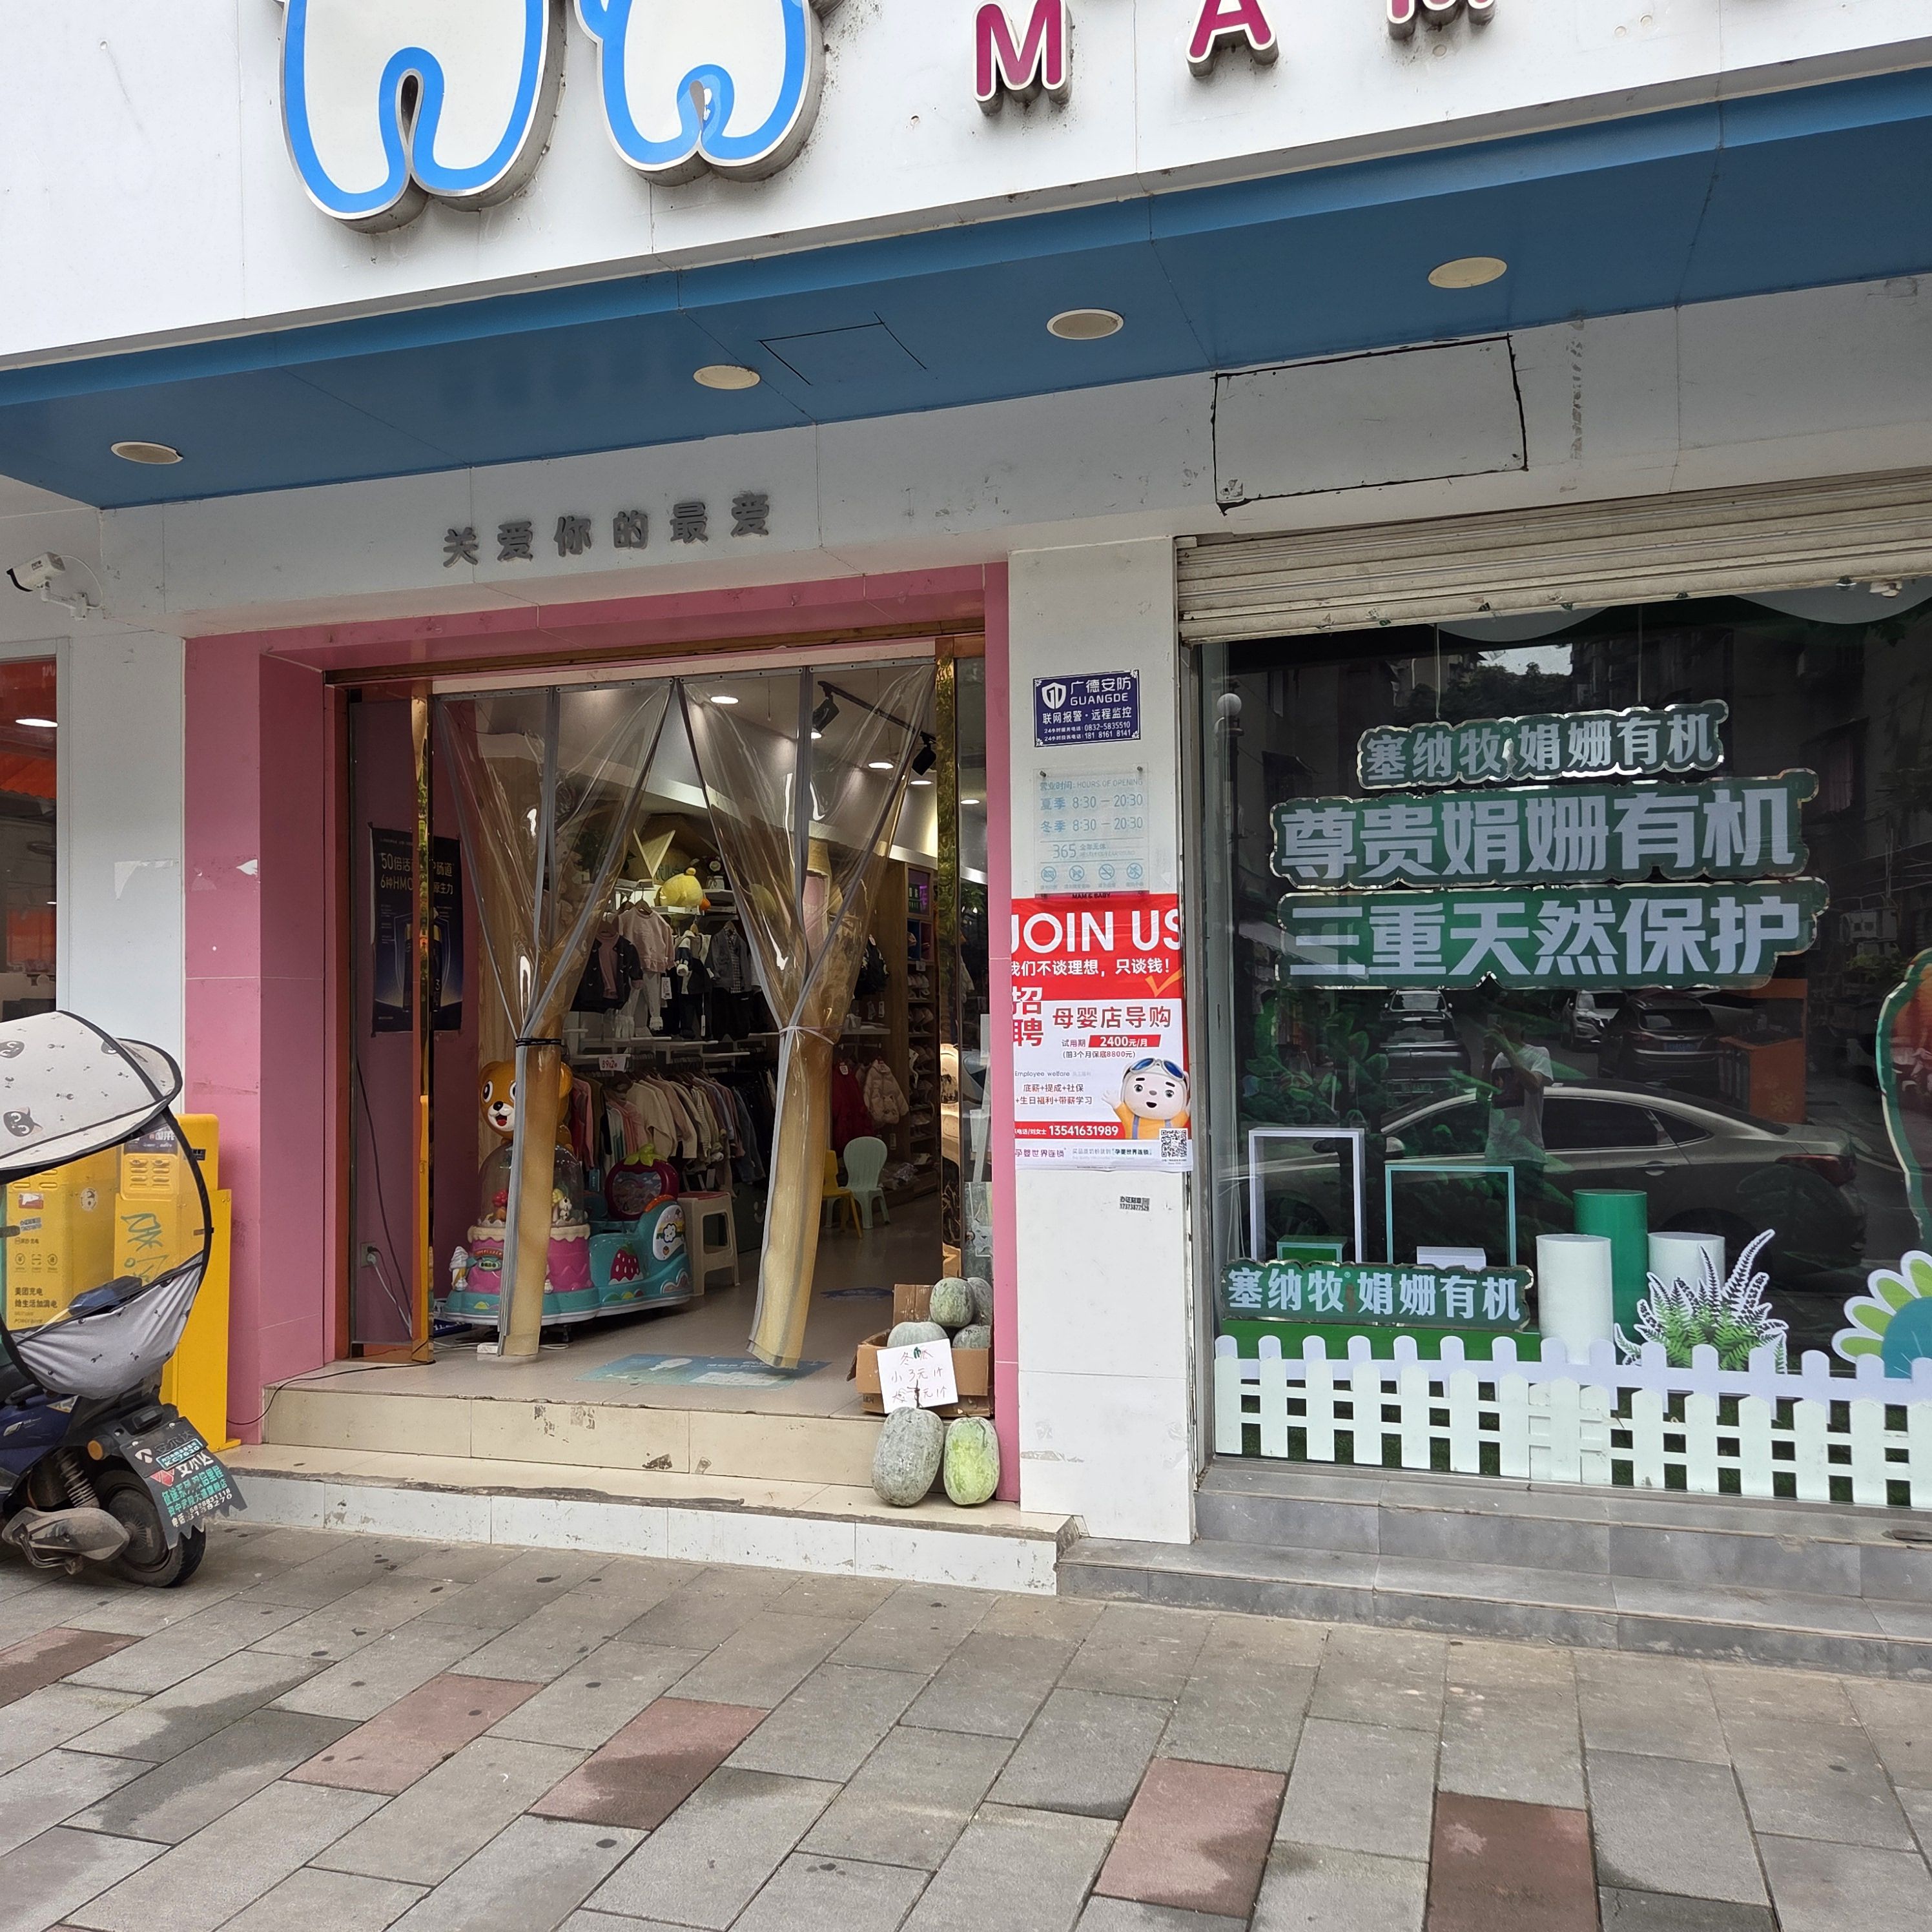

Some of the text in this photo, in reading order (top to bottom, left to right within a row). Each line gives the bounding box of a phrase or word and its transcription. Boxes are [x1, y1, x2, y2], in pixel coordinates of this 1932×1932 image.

[443, 493, 768, 568] 关爱你的最爱
[1071, 677, 1131, 695] 广德安防
[1070, 692, 1129, 706] GUANGDE
[1084, 721, 1131, 732] 0832-5835510
[1076, 780, 1101, 789] HOURS
[1102, 779, 1111, 788] OF
[1113, 778, 1143, 786] OPENING
[1040, 797, 1065, 810] 夏季
[1072, 796, 1096, 809] 8:30
[1114, 794, 1143, 807] 20:30
[1040, 820, 1065, 833] 冬季
[1072, 819, 1096, 832] 8:30
[1114, 816, 1143, 830] 20:30
[1281, 787, 1796, 879] 尊贵娟姗有机
[1053, 843, 1076, 858] 365
[1011, 908, 1181, 954] JOIN US
[1290, 896, 1800, 976] 三重天然保护
[1053, 1005, 1171, 1029] 母婴店导购
[1100, 1036, 1147, 1047] 2400元/月
[1023, 1084, 1084, 1093] 底薪+提成+社保
[1049, 1125, 1118, 1136] 13541631989
